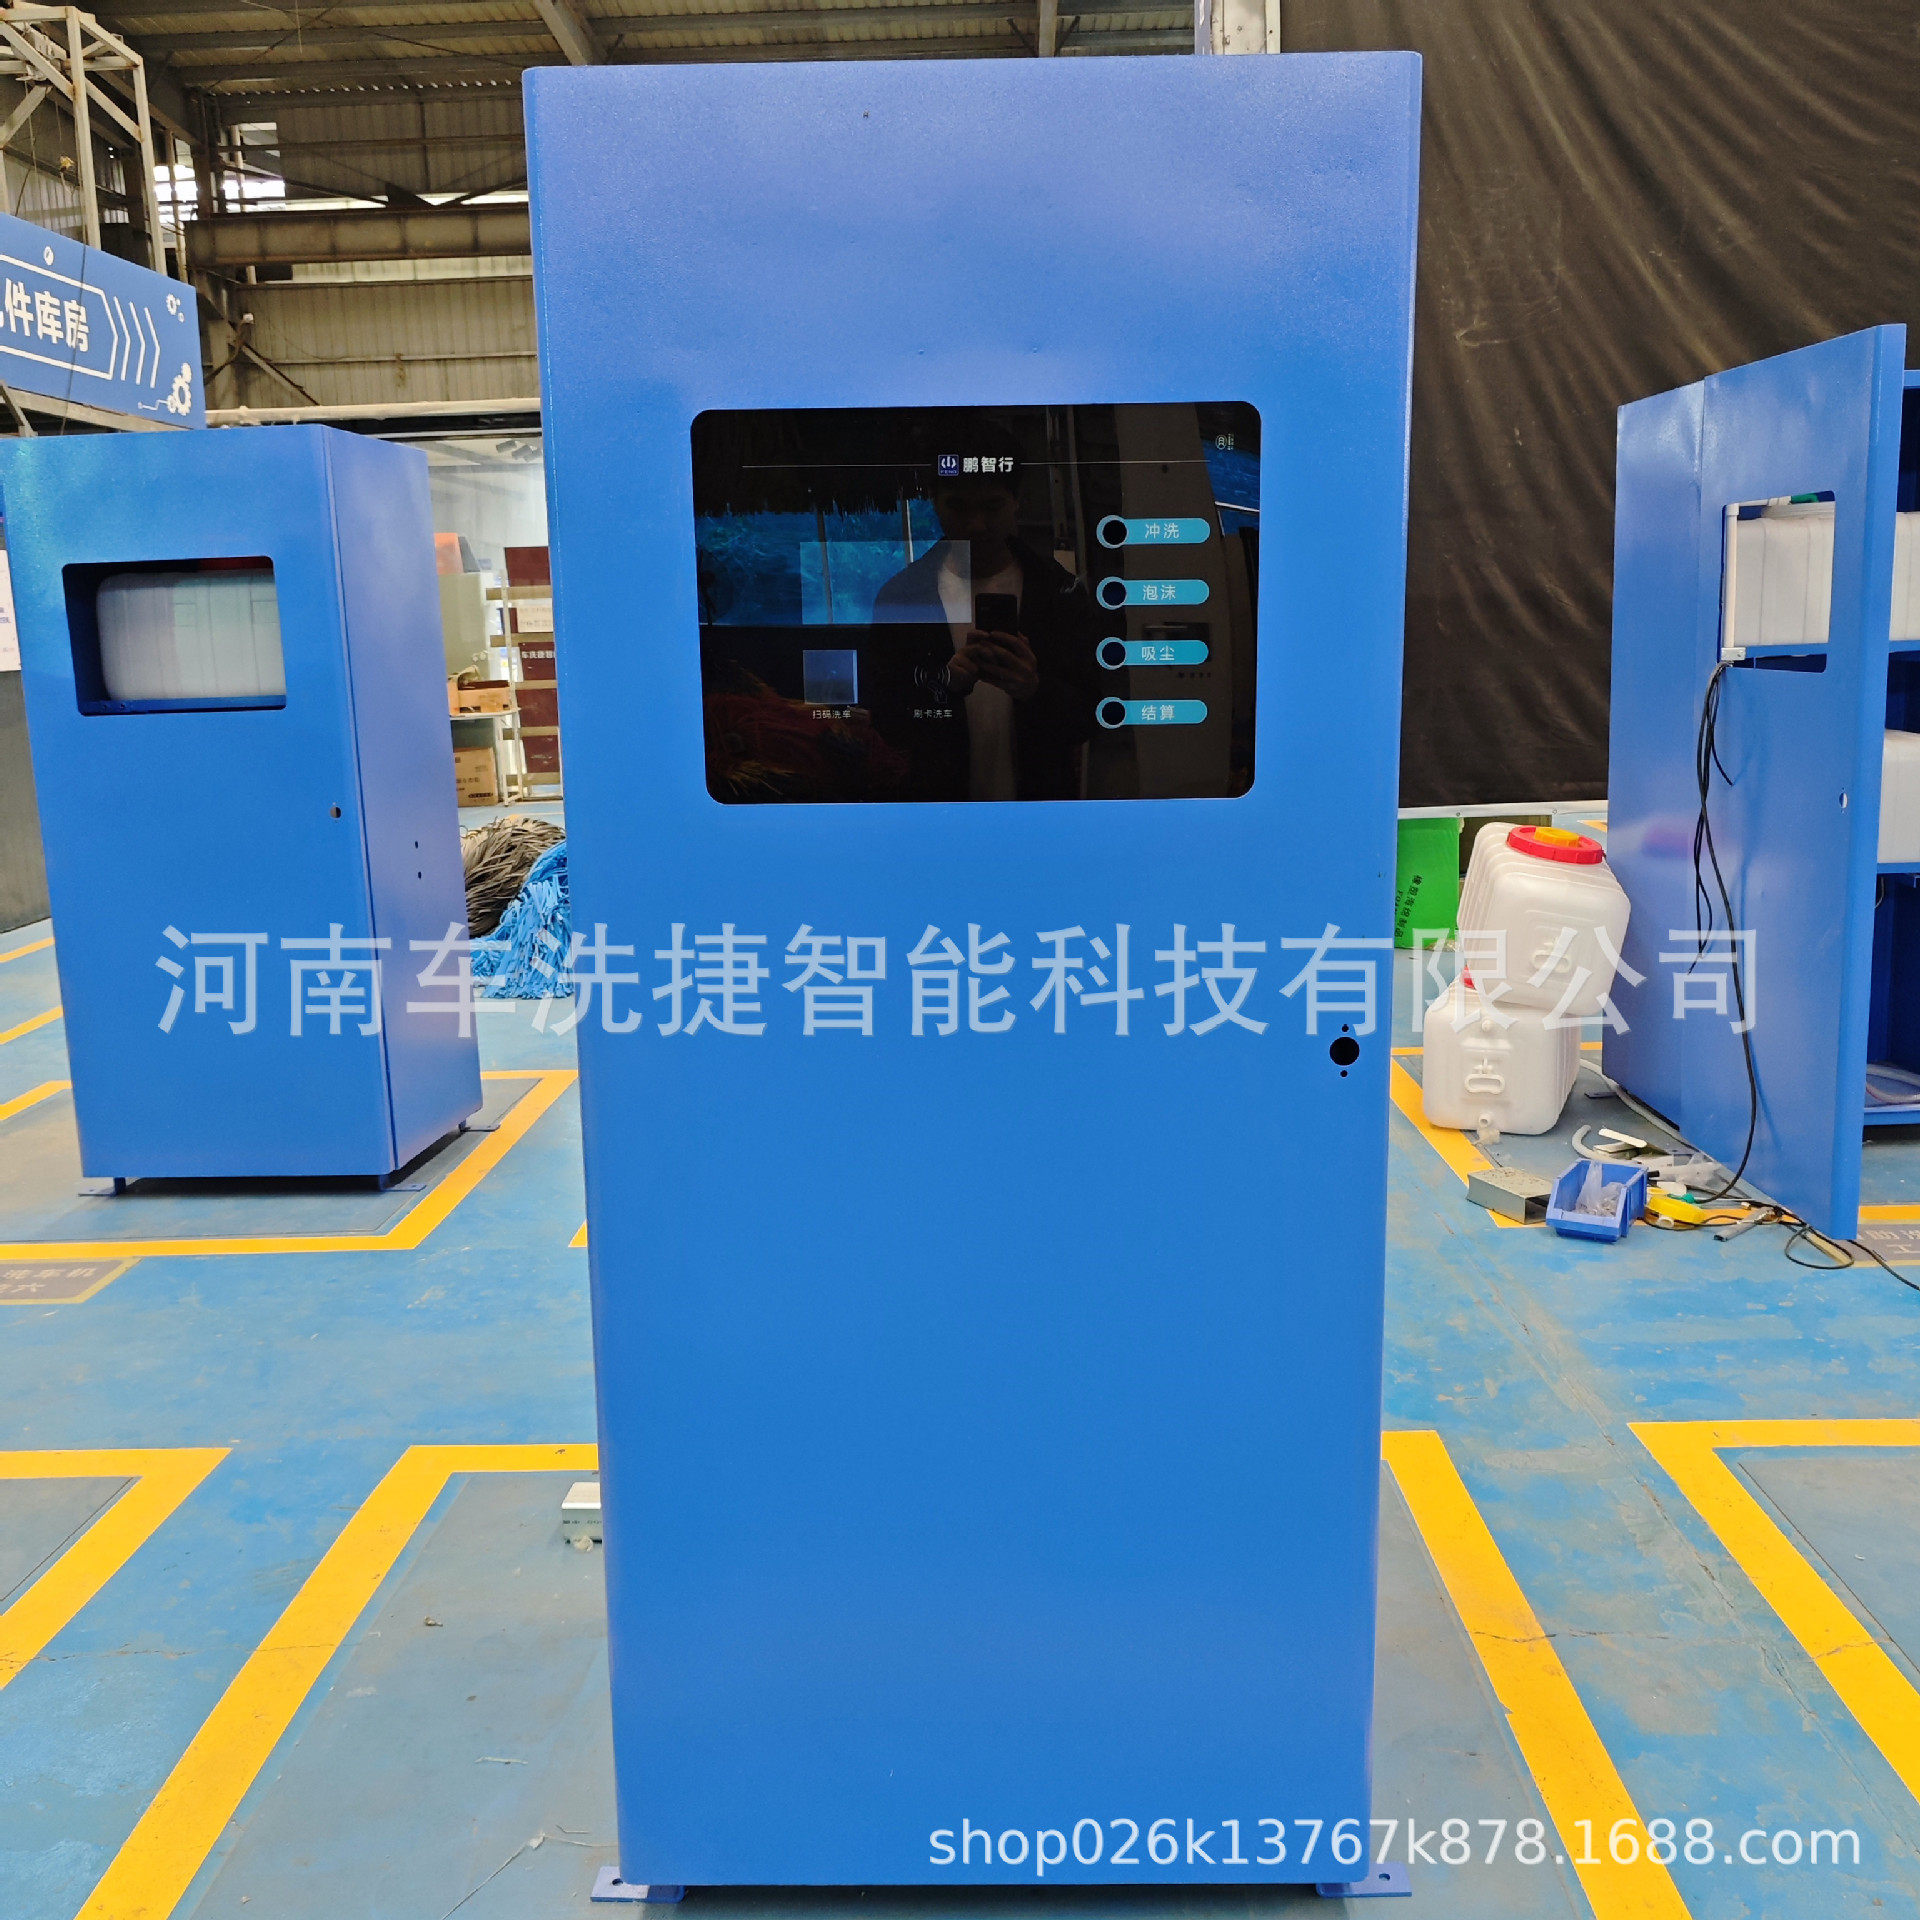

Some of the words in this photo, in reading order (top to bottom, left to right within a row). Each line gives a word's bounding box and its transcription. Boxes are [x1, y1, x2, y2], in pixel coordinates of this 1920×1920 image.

[0, 278, 89, 352] 件库房
[963, 456, 1014, 473] 鹏智行
[1145, 522, 1180, 539] 冲洗
[1142, 584, 1176, 601] 泡沫
[1141, 645, 1175, 661] 吸尘
[812, 709, 852, 719] 扫码洗车
[913, 709, 952, 719] 刷卡洗车
[1141, 704, 1175, 721] 结算
